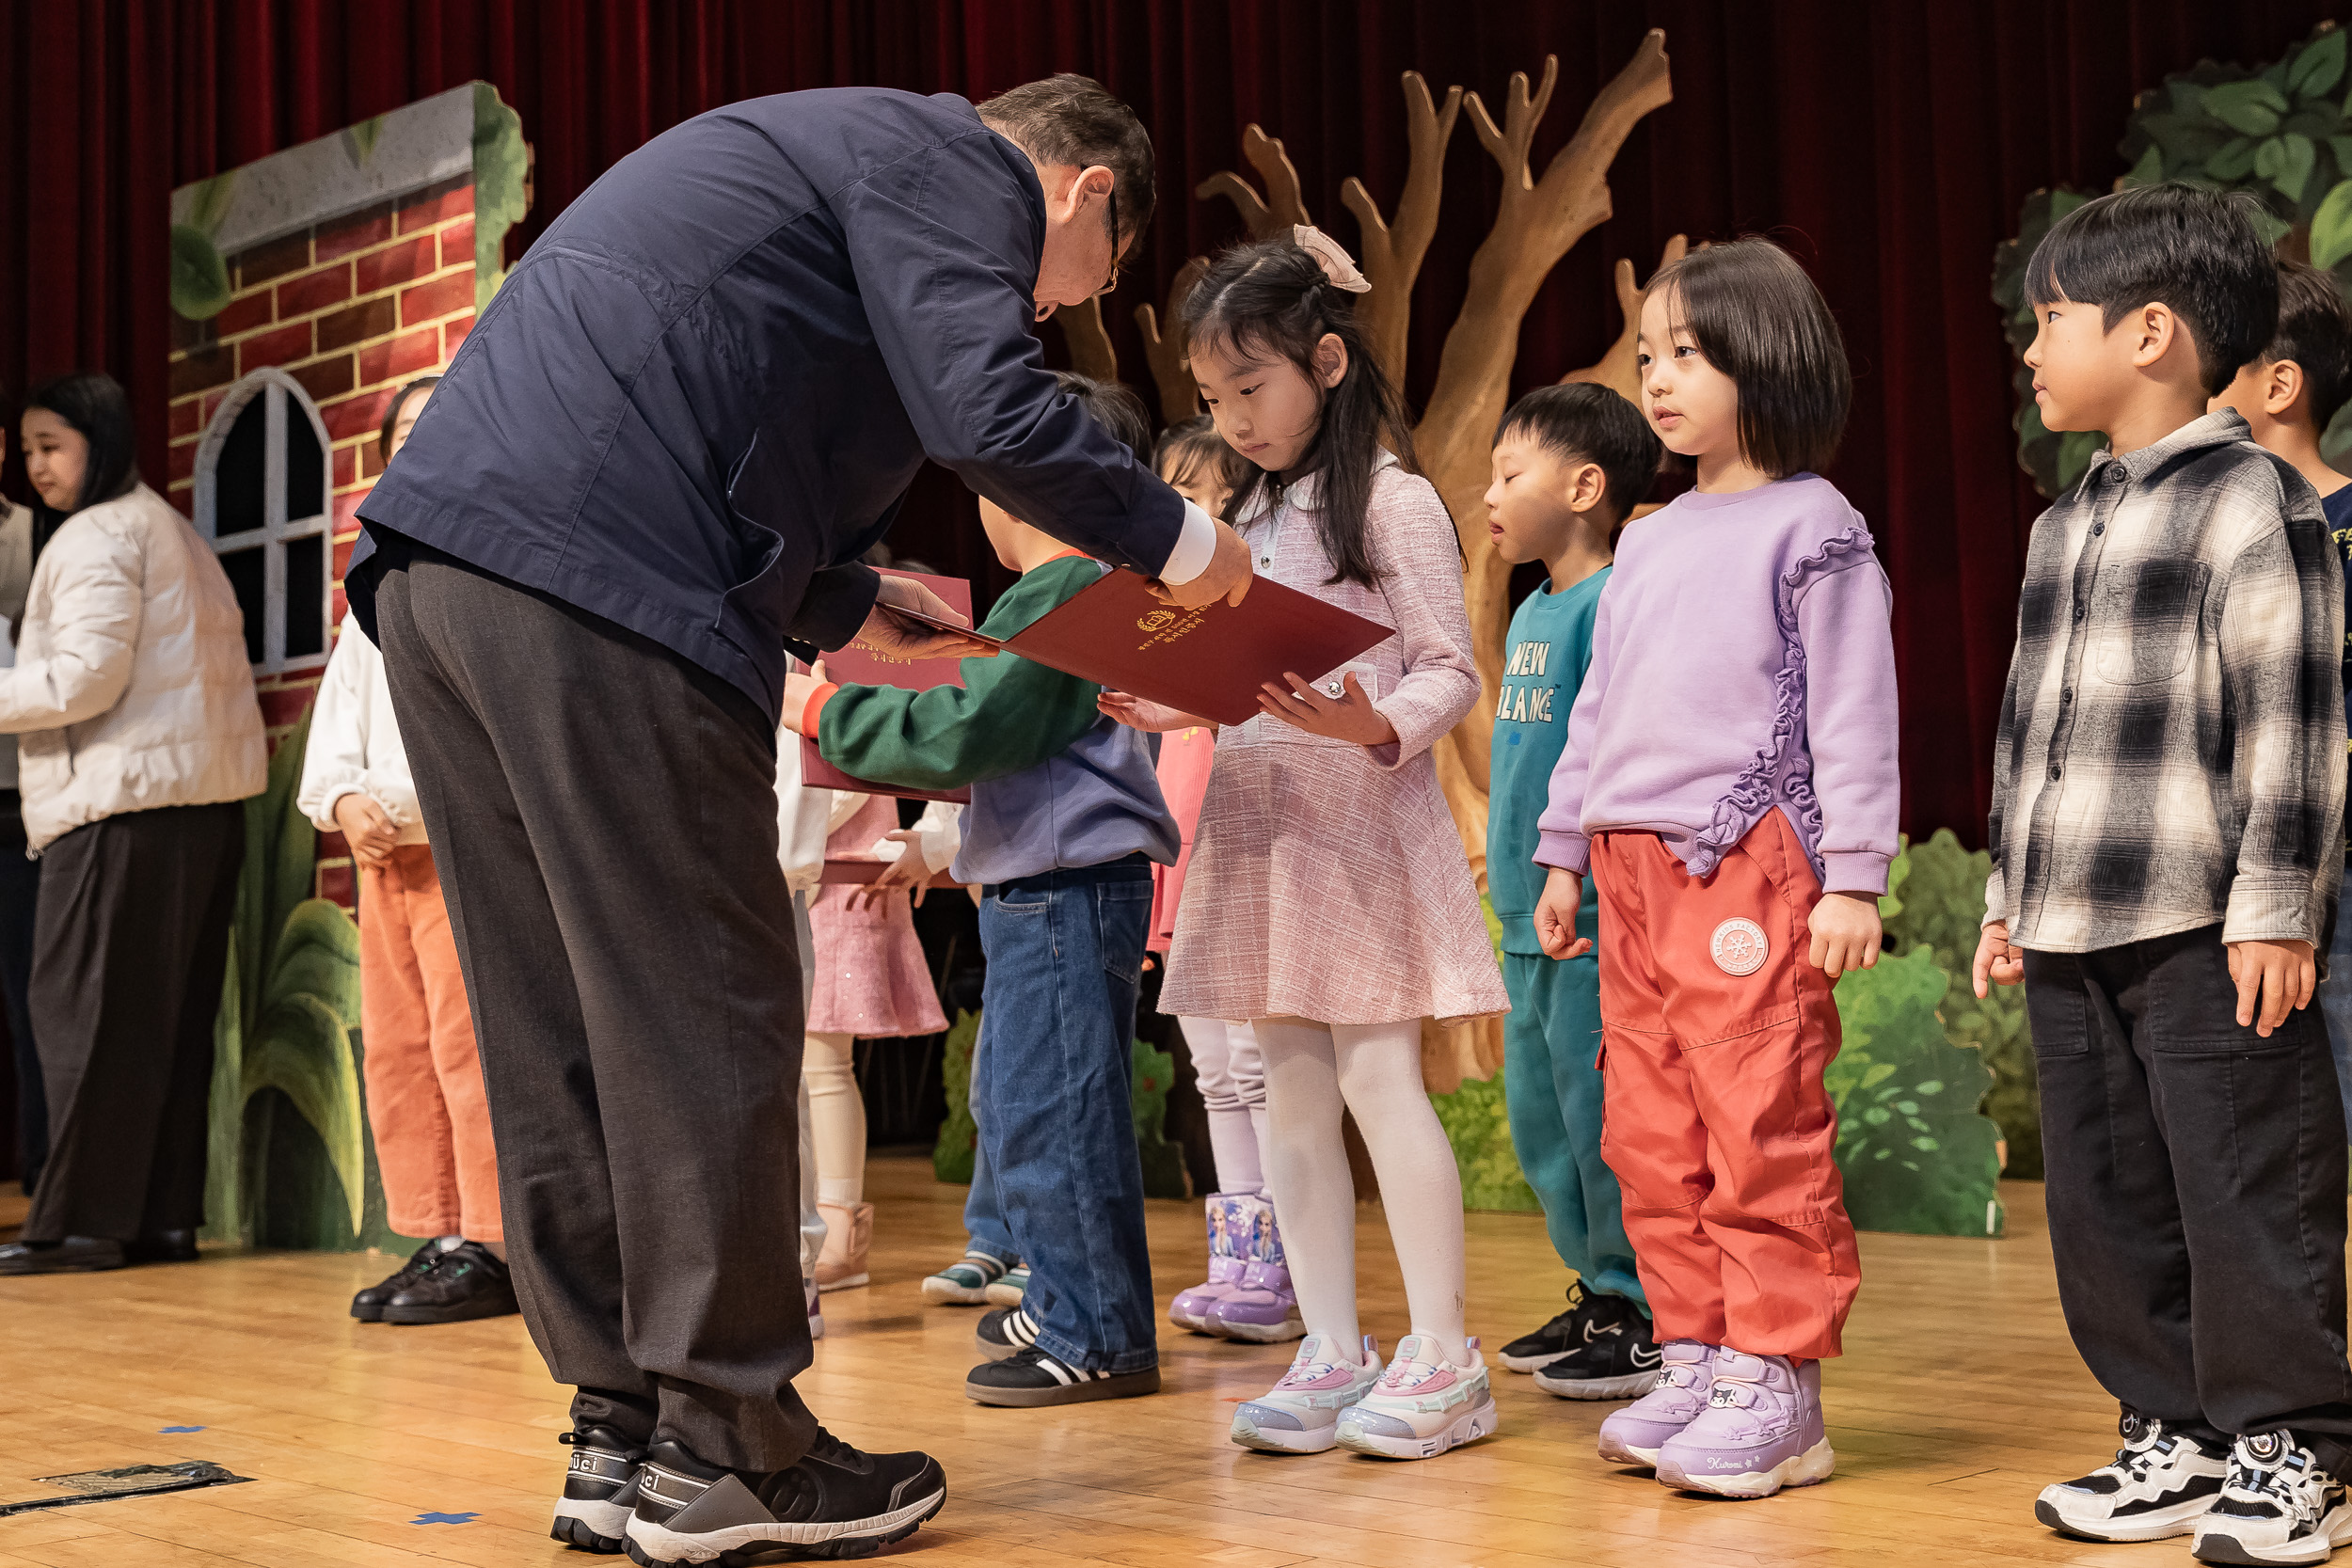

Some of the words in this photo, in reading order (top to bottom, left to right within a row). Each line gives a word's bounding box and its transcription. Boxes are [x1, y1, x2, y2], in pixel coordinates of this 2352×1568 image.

[1506, 641, 1549, 676] NEW
[1737, 923, 1763, 945] FACTORY
[1421, 1418, 1486, 1457] FILA
[1707, 1457, 1743, 1469] Kuromi
